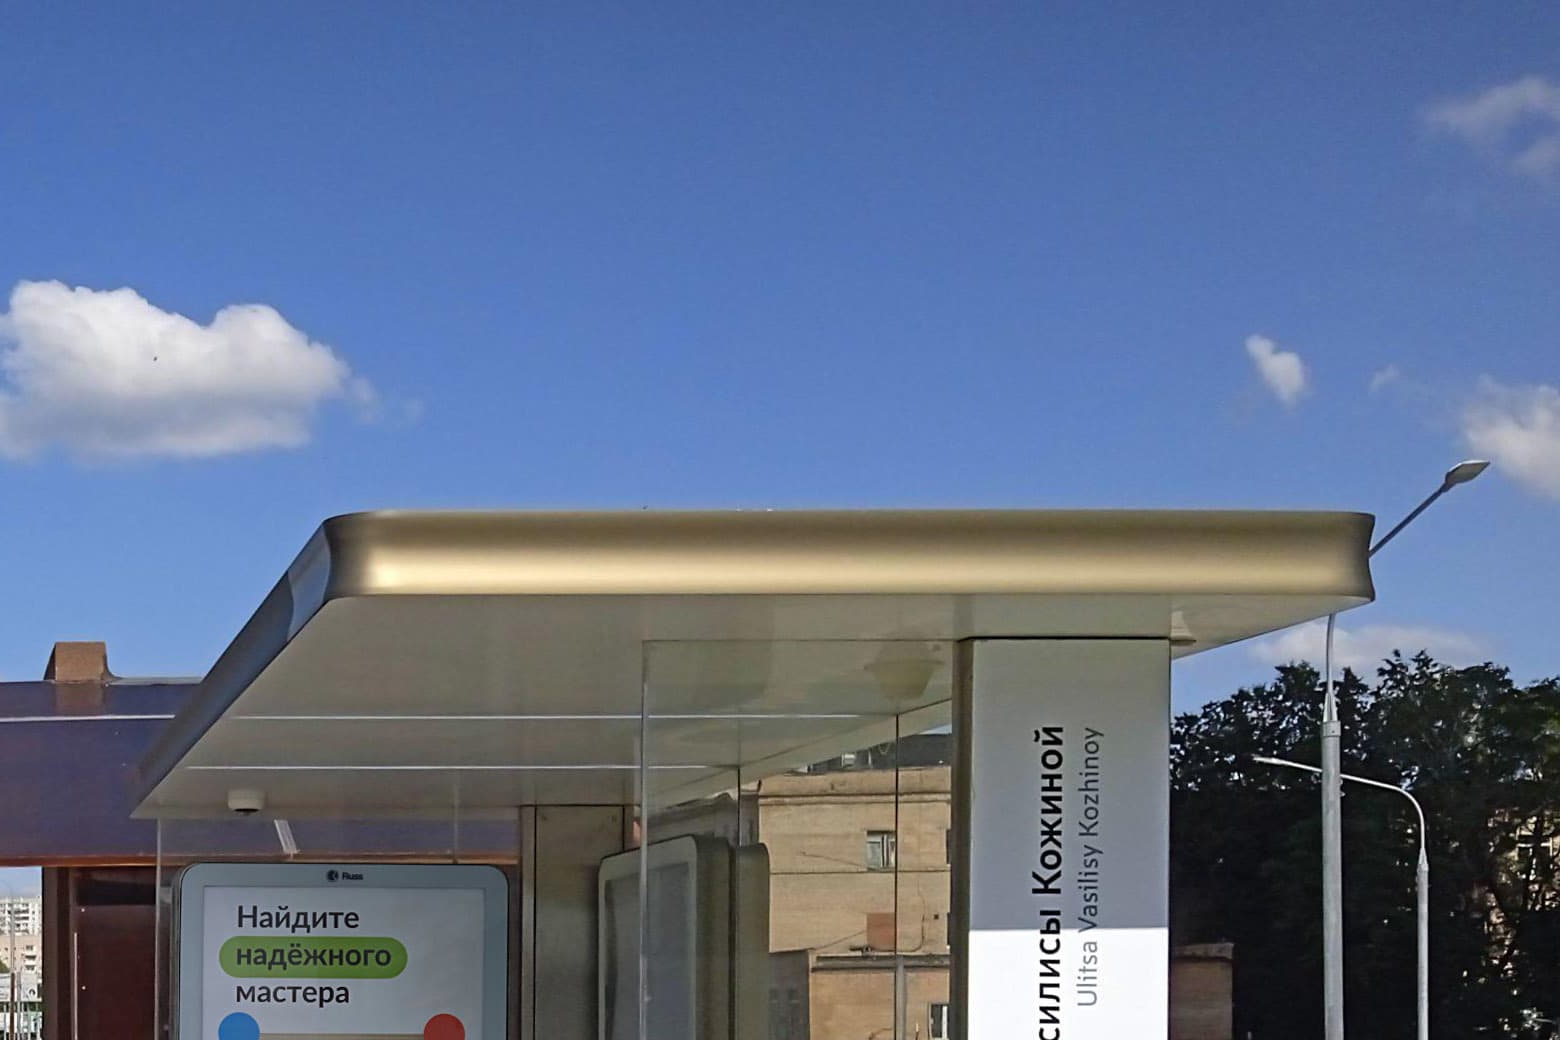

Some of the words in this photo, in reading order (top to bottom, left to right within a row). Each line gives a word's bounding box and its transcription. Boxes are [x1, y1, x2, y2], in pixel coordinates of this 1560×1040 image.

[1031, 726, 1064, 895] Кожиной
[1077, 727, 1105, 837] Kozhinoy
[237, 904, 360, 934] Найдите
[1077, 844, 1104, 933] Vasilisy
[236, 943, 392, 970] надёжного
[1076, 941, 1098, 1006] Ulitsa
[236, 984, 350, 1008] мастера
